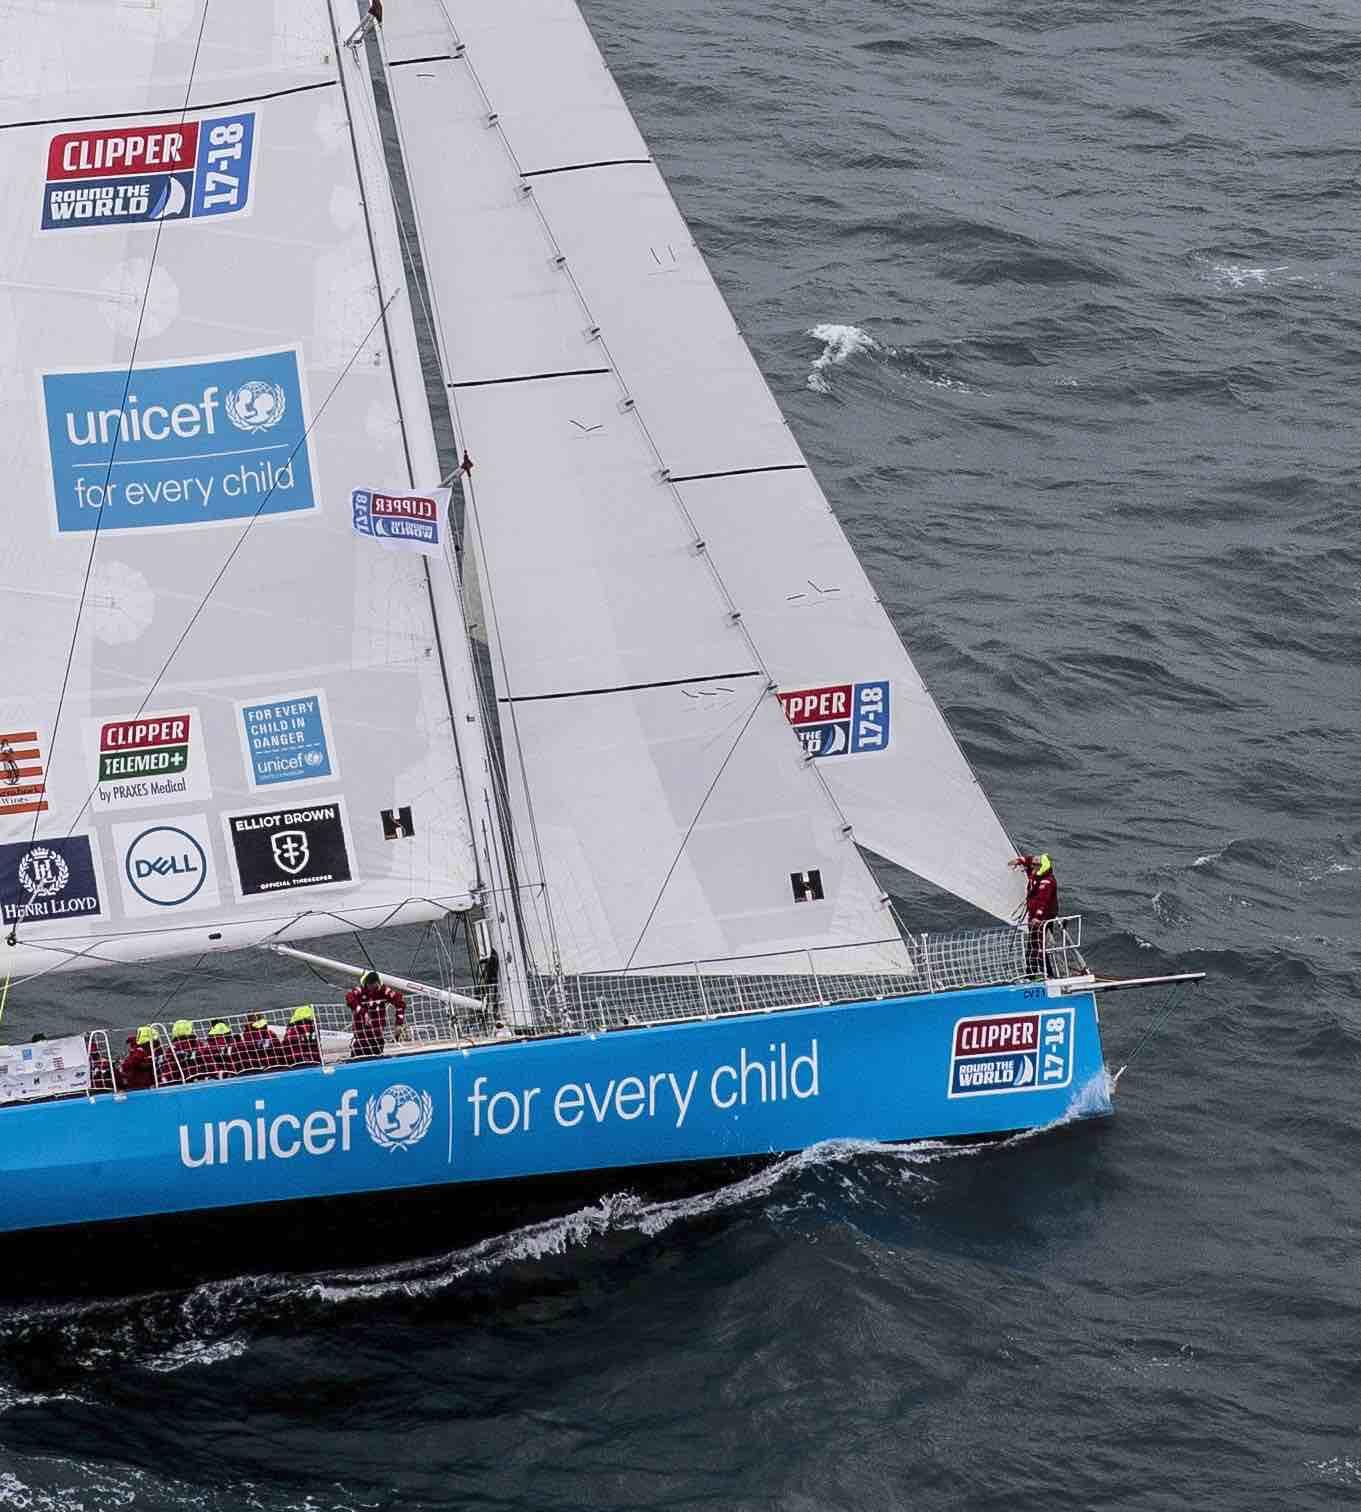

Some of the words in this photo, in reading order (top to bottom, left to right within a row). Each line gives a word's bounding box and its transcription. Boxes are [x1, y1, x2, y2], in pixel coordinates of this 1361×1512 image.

[62, 132, 183, 171] CLIPPER
[203, 122, 244, 209] 17-18
[50, 186, 114, 203] ROUND
[115, 183, 150, 199] THE
[50, 196, 150, 221] WORLD
[66, 386, 219, 446] unicef
[74, 477, 120, 508] for
[125, 476, 214, 507] every
[222, 457, 295, 496] child
[248, 709, 272, 722] FOR
[275, 702, 314, 718] EVERY
[782, 692, 846, 720] IPPER
[858, 687, 883, 748] 17-18
[106, 721, 185, 746] CLIPPER
[251, 721, 289, 736] CHILD
[291, 718, 305, 729] IN
[800, 730, 822, 741] THE
[253, 731, 305, 749] DANGER
[257, 752, 304, 774] unicef
[99, 787, 111, 804] by
[113, 783, 149, 799] PRAXES
[150, 777, 187, 795] Medical
[235, 815, 281, 832] ELLIOT
[284, 808, 335, 825] BROWN
[135, 854, 198, 878] DELL
[50, 897, 97, 914] LLOYD
[961, 1022, 1034, 1050] CLIPPER
[1044, 1017, 1066, 1081] 17-18
[959, 1063, 995, 1074] ROUND
[996, 1059, 1015, 1070] THE
[959, 1070, 1014, 1087] WORLD
[467, 1077, 541, 1136] for
[554, 1069, 699, 1129] every
[711, 1039, 820, 1109] child
[179, 1088, 359, 1168] unicef
